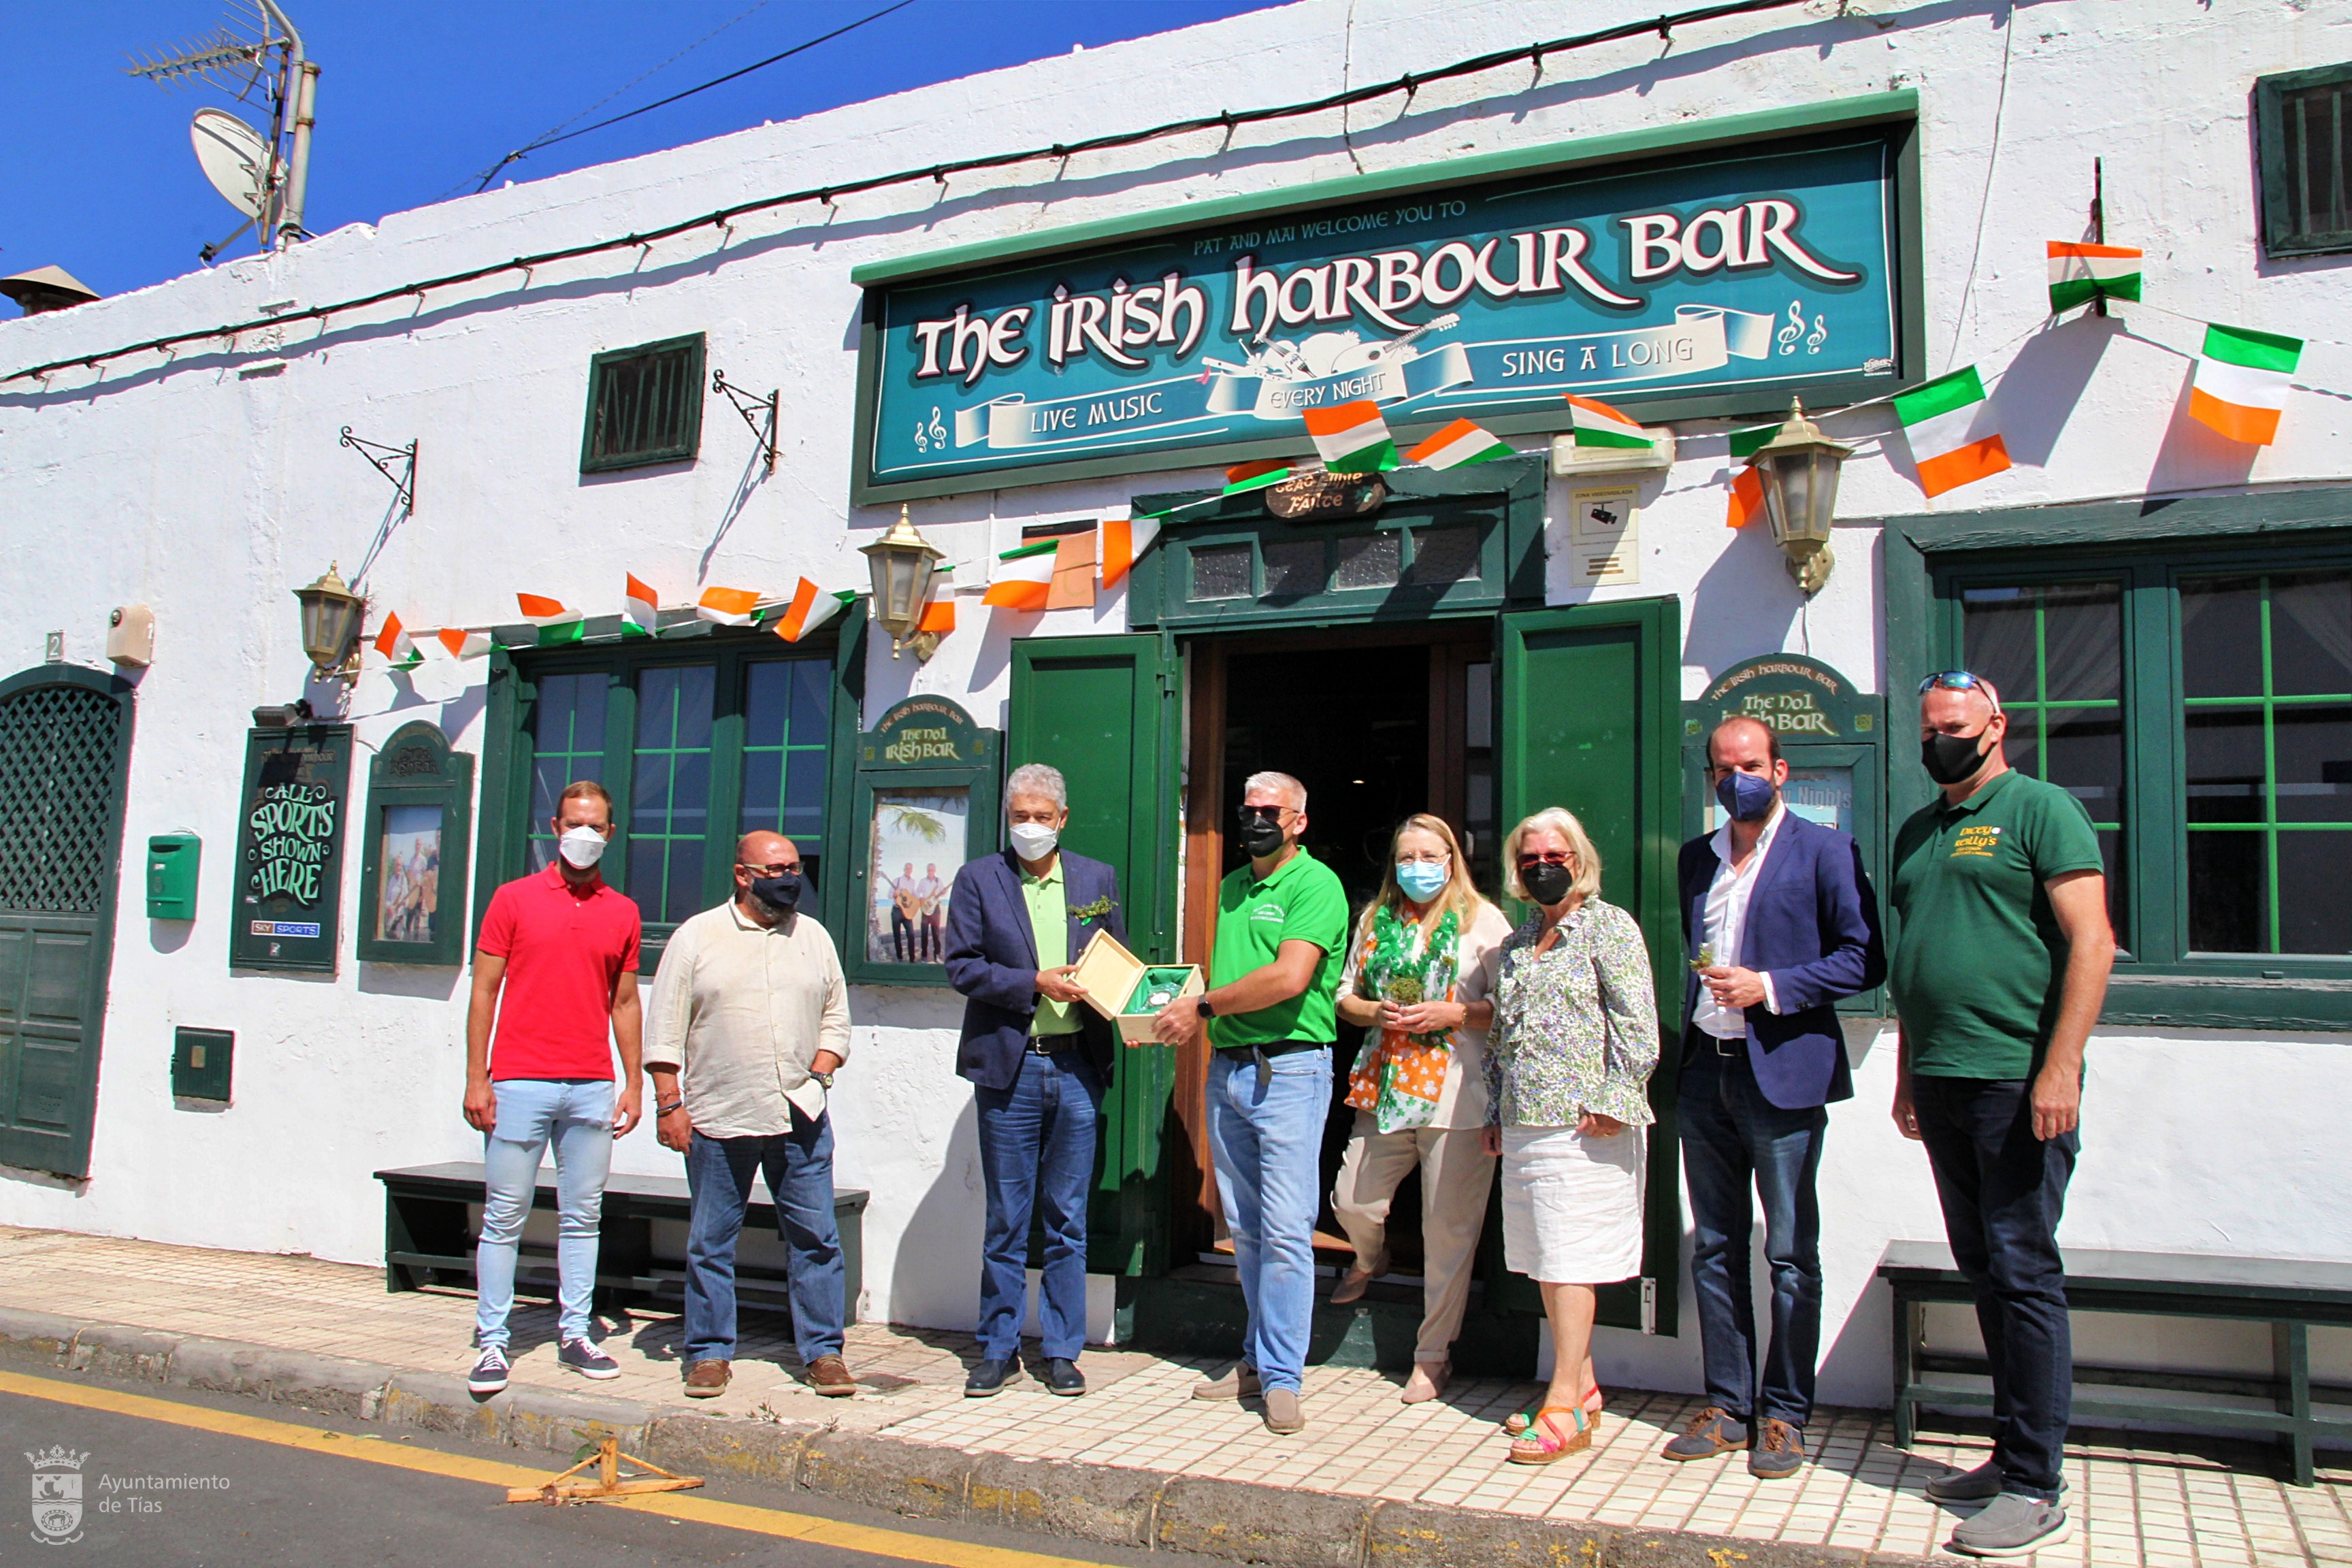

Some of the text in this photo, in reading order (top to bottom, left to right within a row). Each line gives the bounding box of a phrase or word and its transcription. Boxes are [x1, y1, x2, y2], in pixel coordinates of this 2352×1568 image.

[1194, 237, 1223, 256] PAT
[1229, 232, 1260, 250] AND
[1301, 211, 1389, 239] WELCOME
[1395, 206, 1433, 226] YOU
[1439, 200, 1466, 218] TO
[1502, 338, 1693, 378] SING A LONG
[1270, 372, 1386, 408] EVERY NIGHT
[1030, 392, 1162, 434] LIVE MUSIC
[1592, 489, 1633, 497] VIDEOVIGILADA
[49, 636, 60, 656] 2
[265, 782, 323, 804] ALL
[1797, 785, 1853, 811] Nights
[250, 800, 336, 843] SPORTS
[261, 836, 323, 862] SHOWN
[252, 858, 323, 906] HERE
[255, 924, 317, 935] SKY SPORTS
